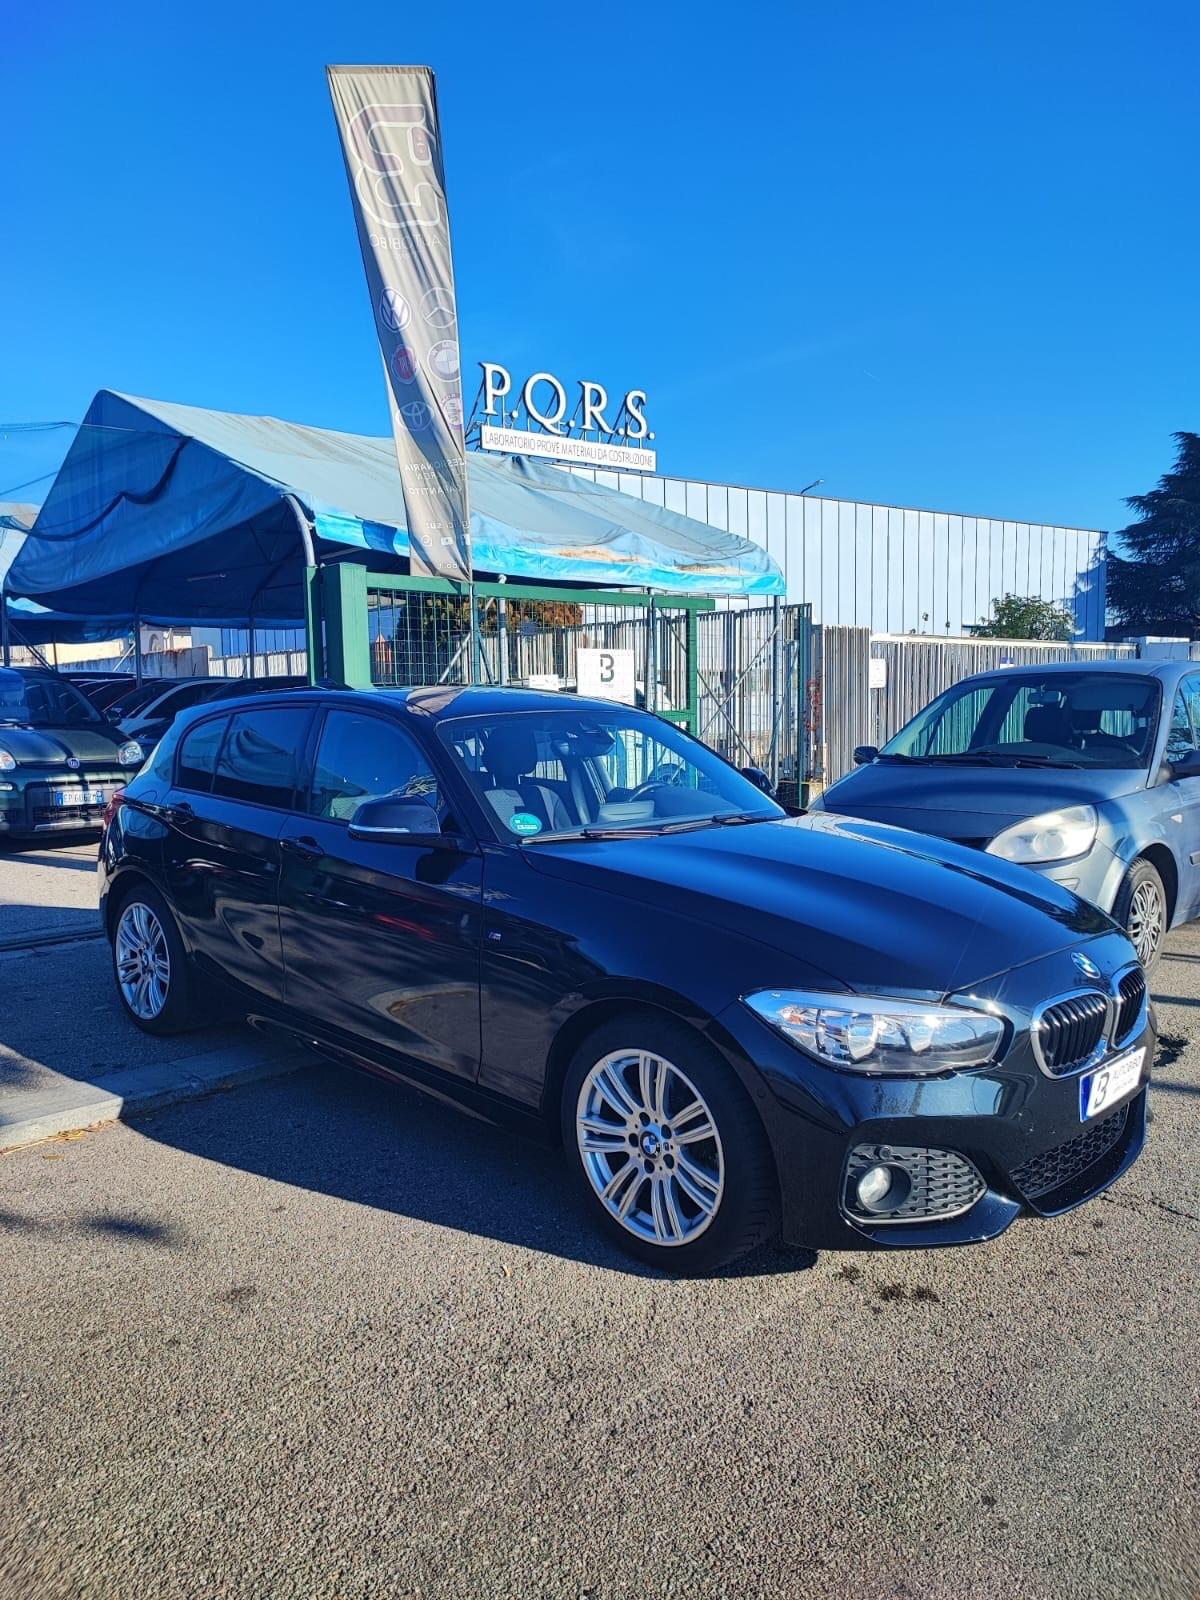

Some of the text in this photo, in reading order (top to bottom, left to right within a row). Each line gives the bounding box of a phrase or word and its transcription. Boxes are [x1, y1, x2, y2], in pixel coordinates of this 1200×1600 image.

[479, 362, 655, 440] P.Q.R.S.
[484, 432, 654, 468] LABORATORIO PROVE MATERIALI DA COSTRUZIONE
